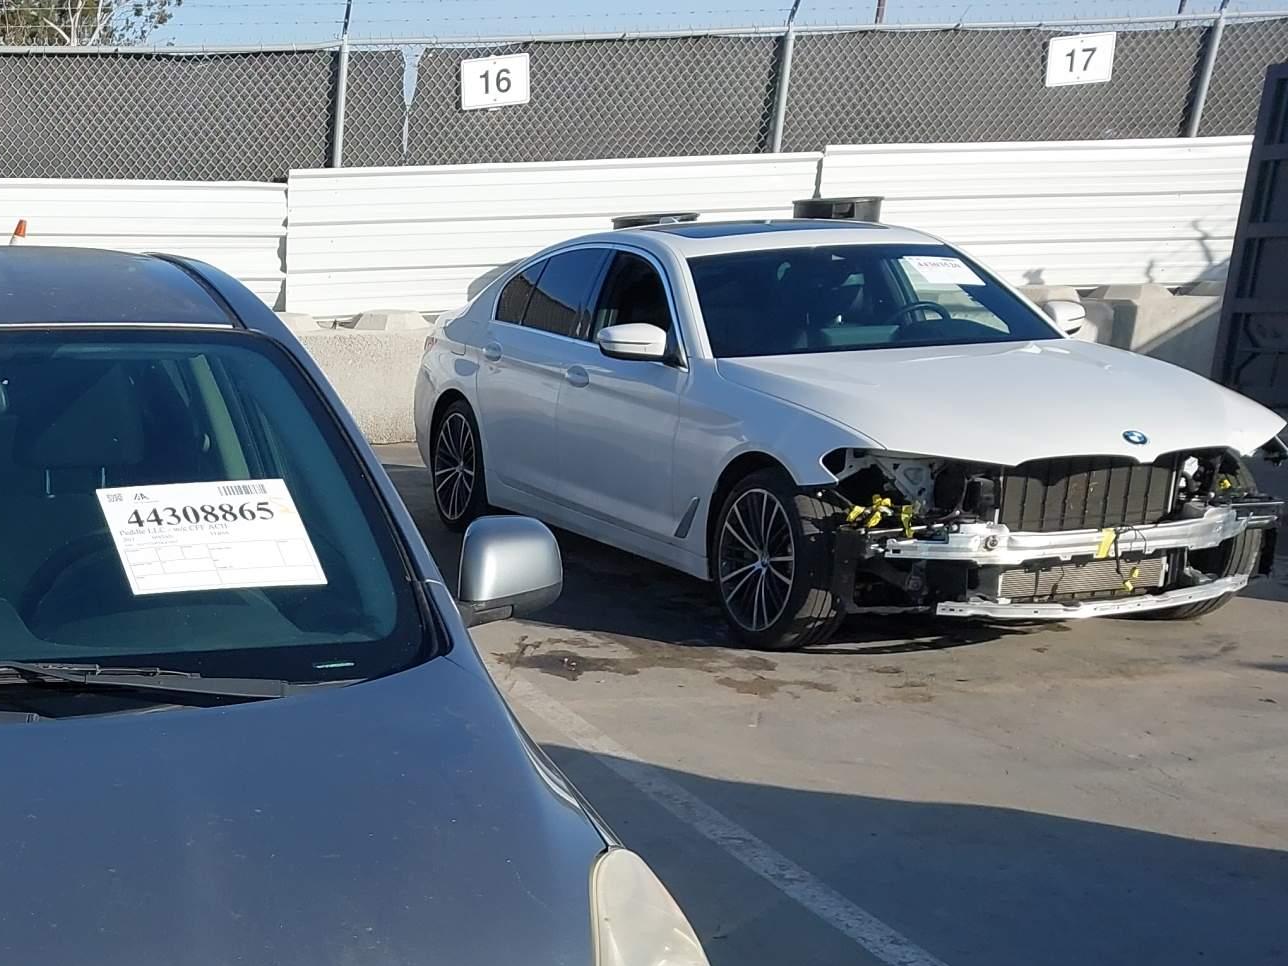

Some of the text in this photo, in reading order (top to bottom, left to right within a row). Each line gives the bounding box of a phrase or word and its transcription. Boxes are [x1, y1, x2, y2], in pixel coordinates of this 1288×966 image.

[1066, 47, 1095, 72] 17
[479, 69, 511, 94] 16
[127, 502, 274, 527] 44308865
